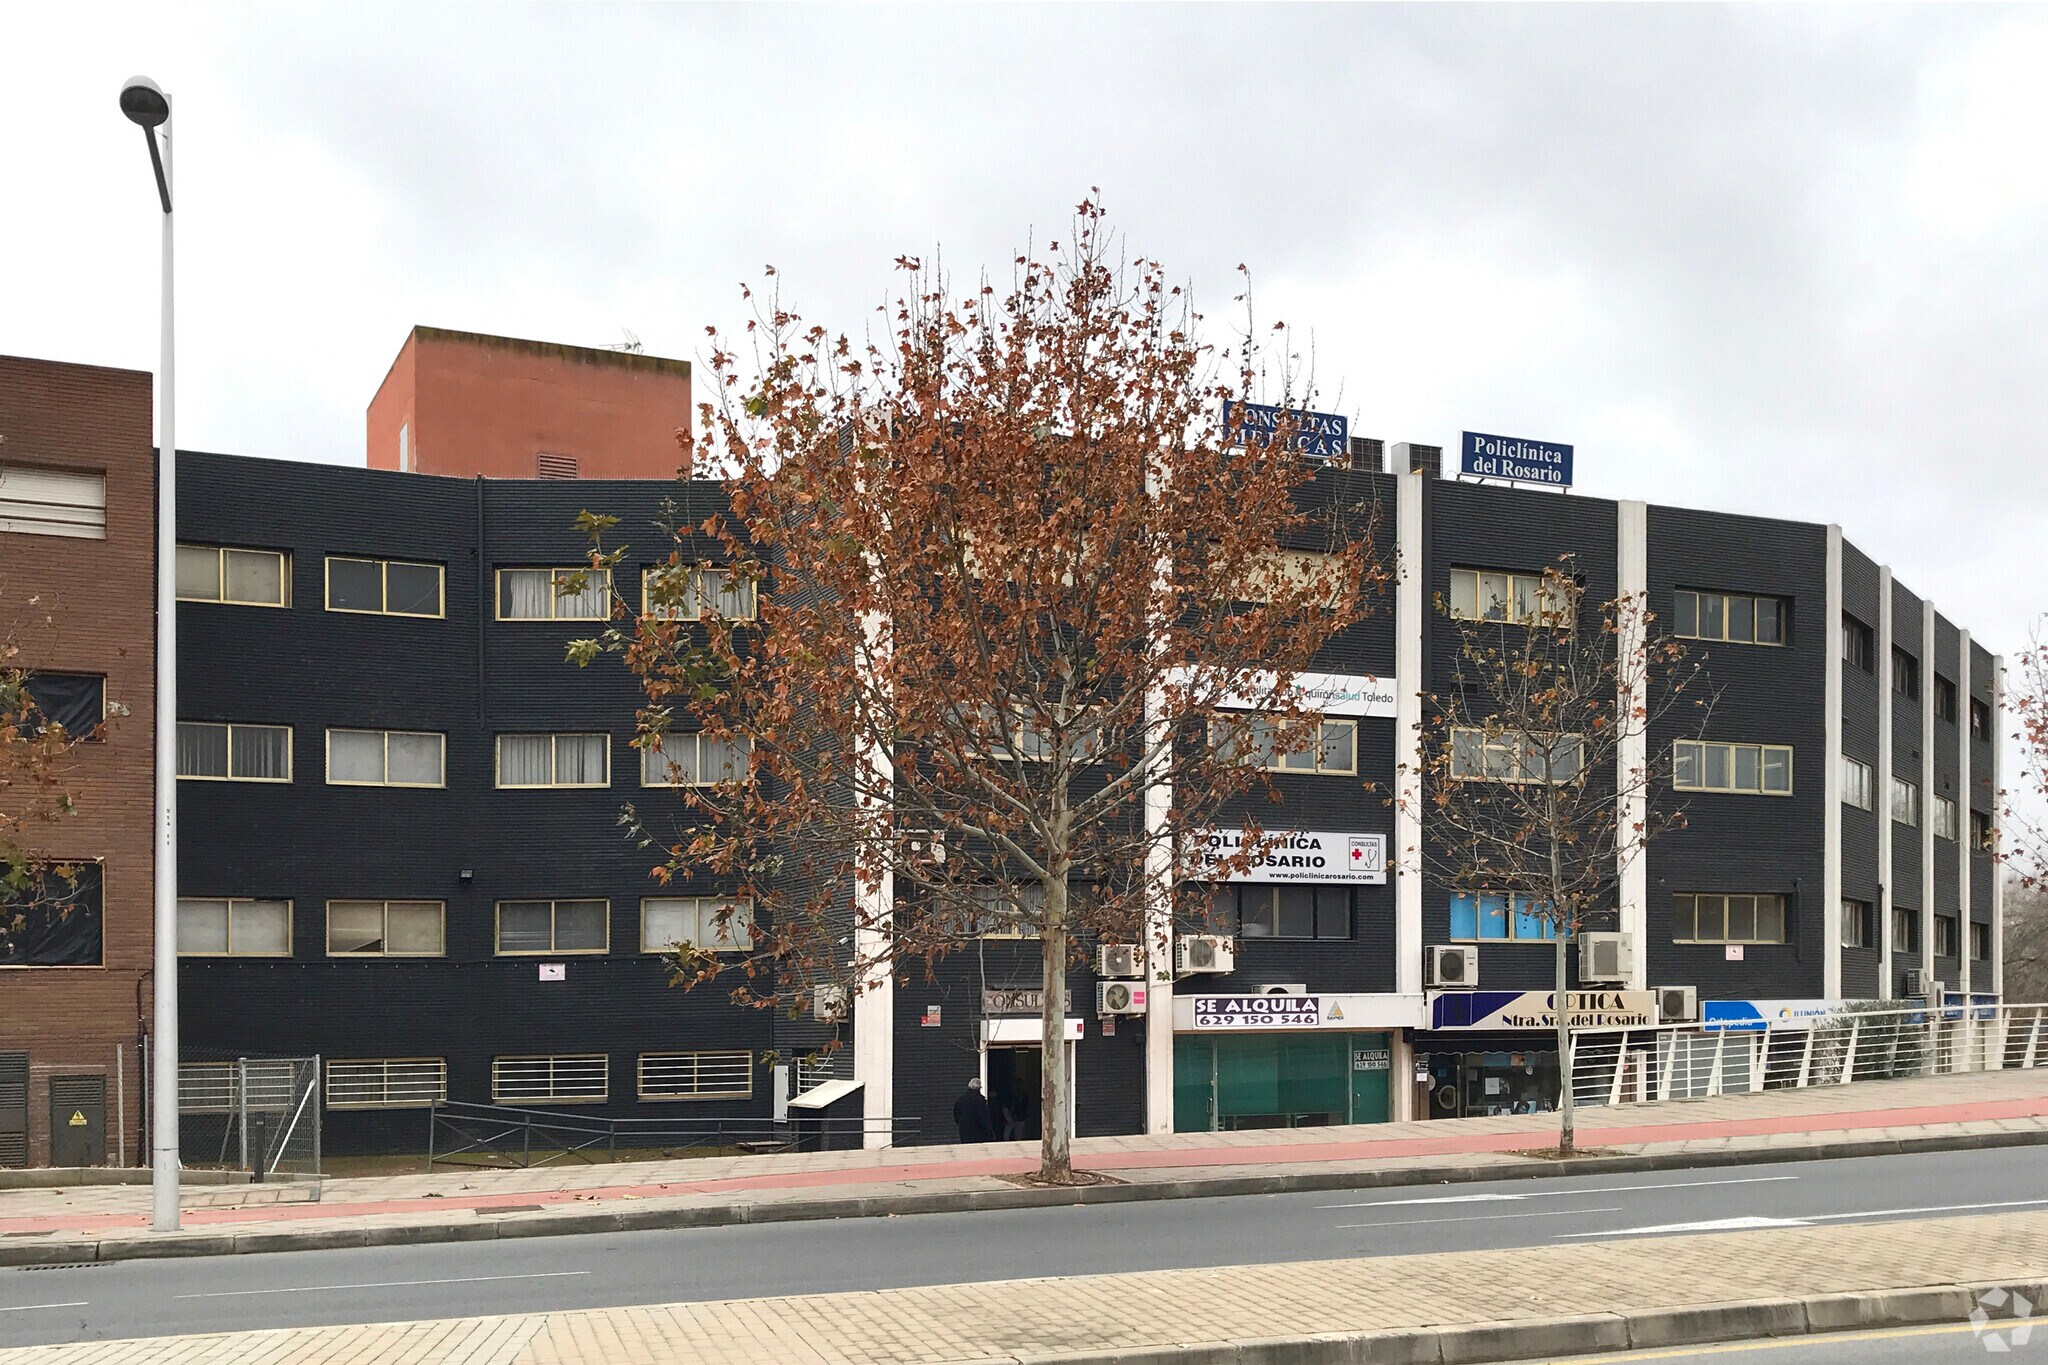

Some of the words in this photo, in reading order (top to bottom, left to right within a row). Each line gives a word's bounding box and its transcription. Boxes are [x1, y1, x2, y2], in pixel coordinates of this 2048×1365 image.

[1474, 436, 1562, 464] Policlínica
[1473, 456, 1497, 474] del
[1501, 459, 1562, 482] Rosario
[1362, 692, 1394, 703] Toledo
[1238, 854, 1326, 868] OSARIO
[1269, 872, 1374, 880] www.policlinicarosario.com
[1196, 999, 1217, 1013] SE
[1225, 998, 1317, 1014] ALQUILA
[1200, 1015, 1235, 1025] 629
[1242, 1015, 1273, 1025] 150
[1281, 1014, 1315, 1024] 546
[1597, 1013, 1650, 1026] Rosario
